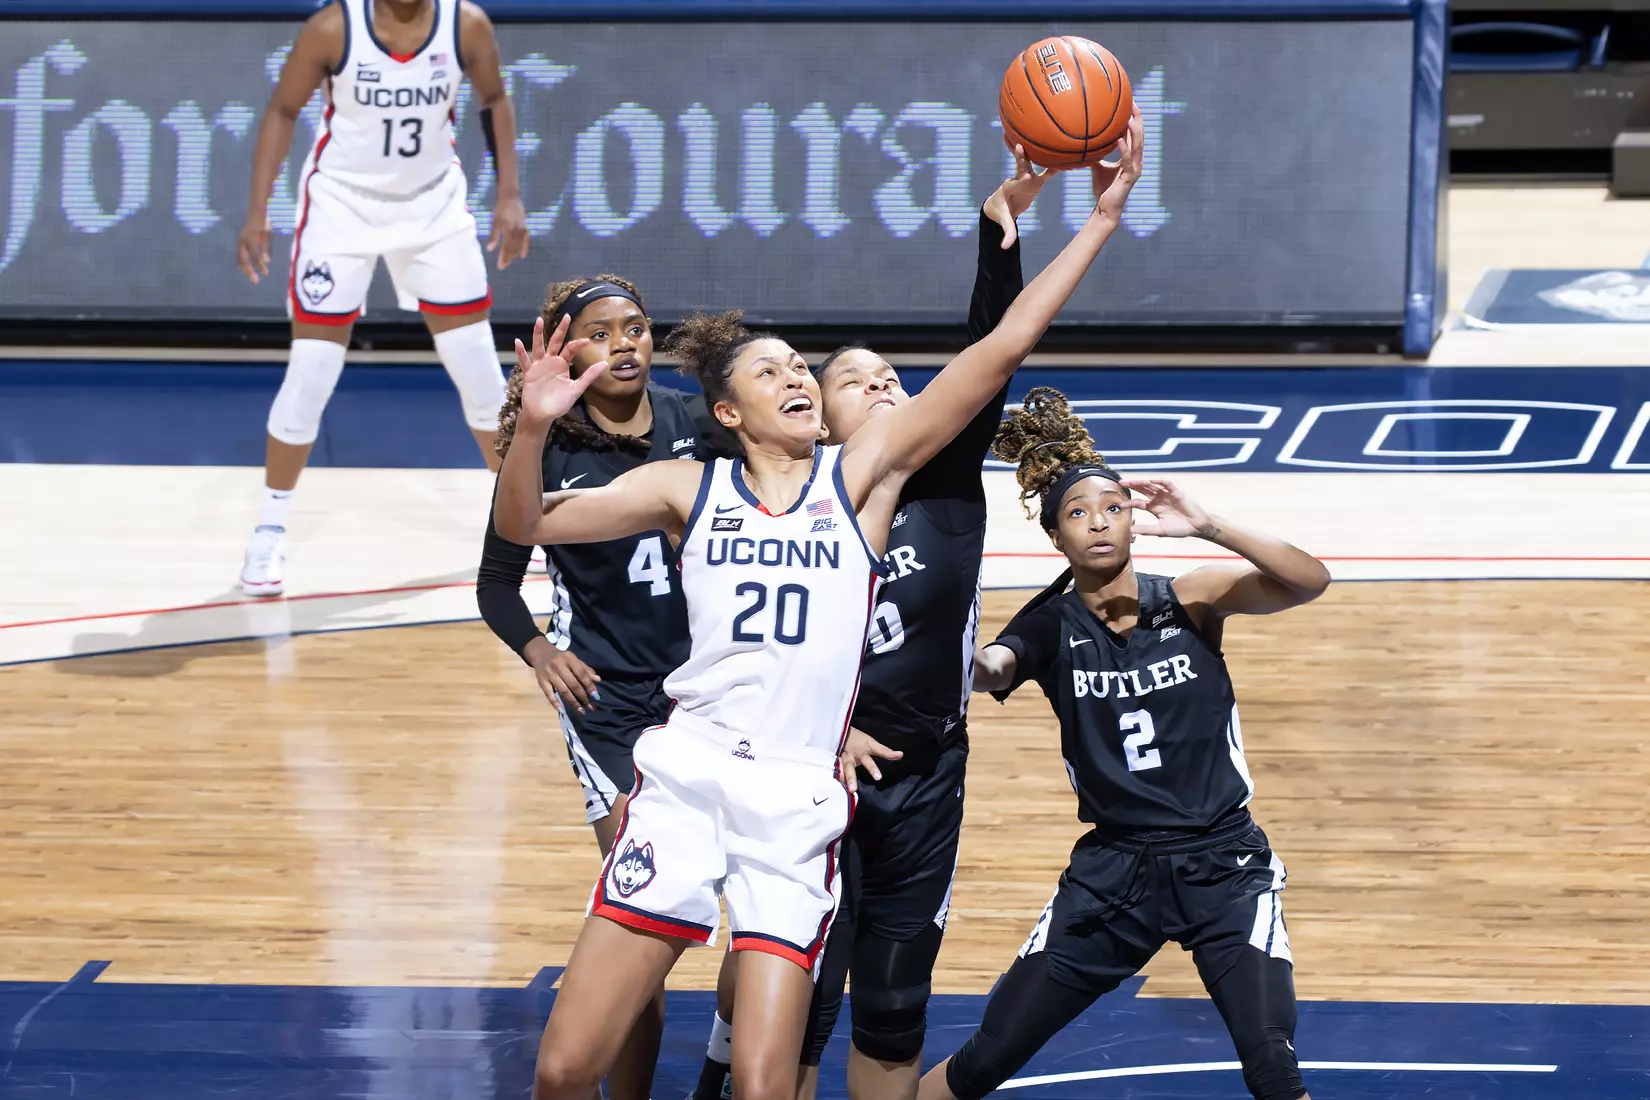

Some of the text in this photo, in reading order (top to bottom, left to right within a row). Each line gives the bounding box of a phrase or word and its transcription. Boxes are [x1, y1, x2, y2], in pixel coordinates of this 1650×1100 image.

[354, 82, 450, 108] UCONN
[381, 117, 424, 158] 13
[0, 38, 325, 271] for
[672, 437, 695, 450] BLM
[715, 519, 741, 528] BLM
[811, 523, 838, 531] EAST
[814, 517, 832, 525] BIG
[627, 535, 672, 597] 4
[706, 537, 840, 569] UCONN
[732, 581, 810, 646] 20
[1072, 654, 1198, 698] BUTLER
[731, 749, 755, 761] UCONN
[1119, 708, 1162, 772] 2
